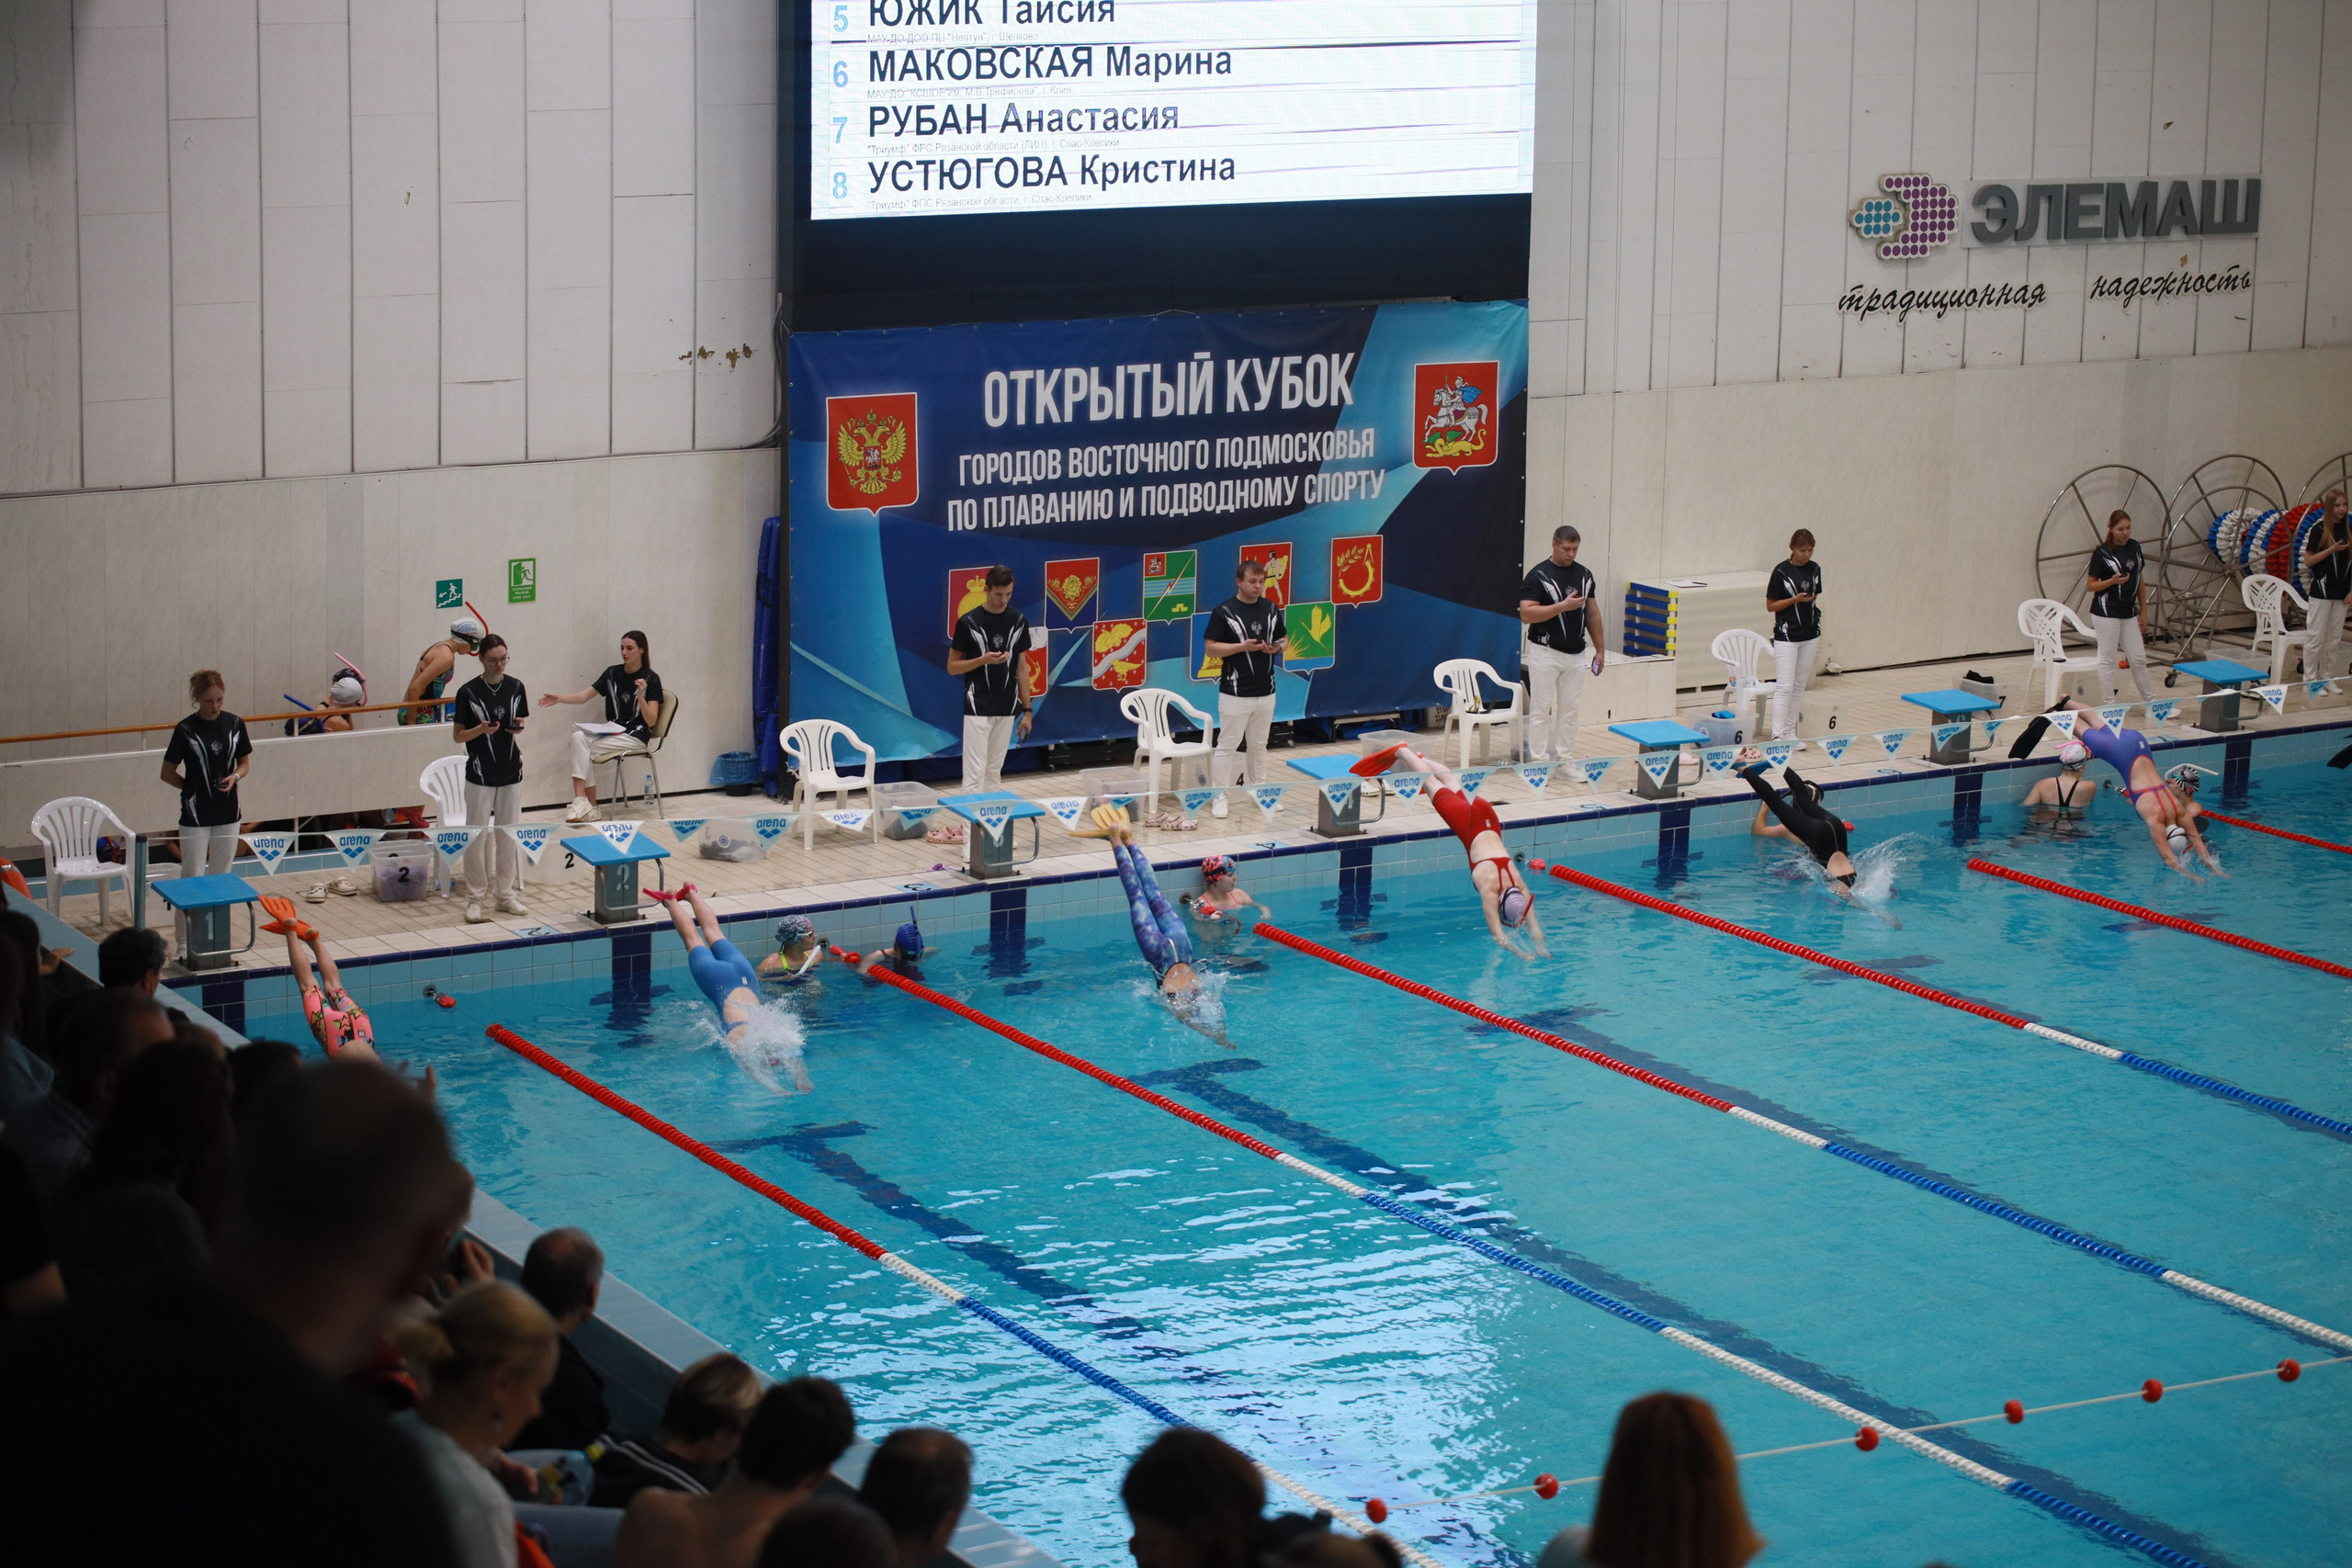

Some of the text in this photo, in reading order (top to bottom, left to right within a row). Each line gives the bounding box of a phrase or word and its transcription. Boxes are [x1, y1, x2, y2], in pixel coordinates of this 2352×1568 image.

[832, 5, 849, 32] 5
[999, 31, 1039, 43] Щелково
[832, 46, 1232, 88] 6 МАКОВСКАЯ Марина
[832, 103, 1179, 143] 7 РУБАН Анастасия
[935, 141, 981, 152] Рязанской
[983, 141, 1019, 152] области
[1059, 138, 1120, 149] Спас-Клепики
[832, 154, 1236, 199] 8 УСТЮГОВА Кристина
[935, 197, 981, 208] Рязанской
[1031, 193, 1091, 204] Спас-Клепики
[1970, 178, 2262, 244] ЭЛЕМАШ
[1838, 265, 2252, 323] традиционная надежность
[983, 352, 1355, 427] ОТКРЫТЫЙ КУБОК
[958, 427, 1375, 487] ГОРОДОВ ВОСТОЧНОГО ПОДМОСКОВЬЯ
[947, 468, 1385, 532] ПО ПЛАВАНИЮ И ПОДВОДНОМУ СПОРТУ
[2102, 708, 2123, 718] arena
[2152, 702, 2173, 713] arena
[1883, 733, 1904, 743] arena
[1766, 744, 1791, 755] arena
[1826, 739, 1848, 750] arena
[1645, 755, 1670, 766] arena
[1707, 750, 1733, 761] arena
[1584, 761, 1608, 772] arena
[1461, 771, 1485, 783] arena
[1523, 767, 1548, 778] arena
[1394, 777, 1420, 788] arena
[1256, 787, 1281, 798] arena
[1328, 783, 1352, 794] arena
[1185, 792, 1212, 803] arena
[1050, 799, 1080, 810] arena
[979, 806, 1008, 817] arena
[756, 818, 786, 829] arena
[436, 831, 469, 842] arena
[516, 829, 547, 840] arena
[254, 837, 286, 850] arena
[339, 834, 371, 847] arena
